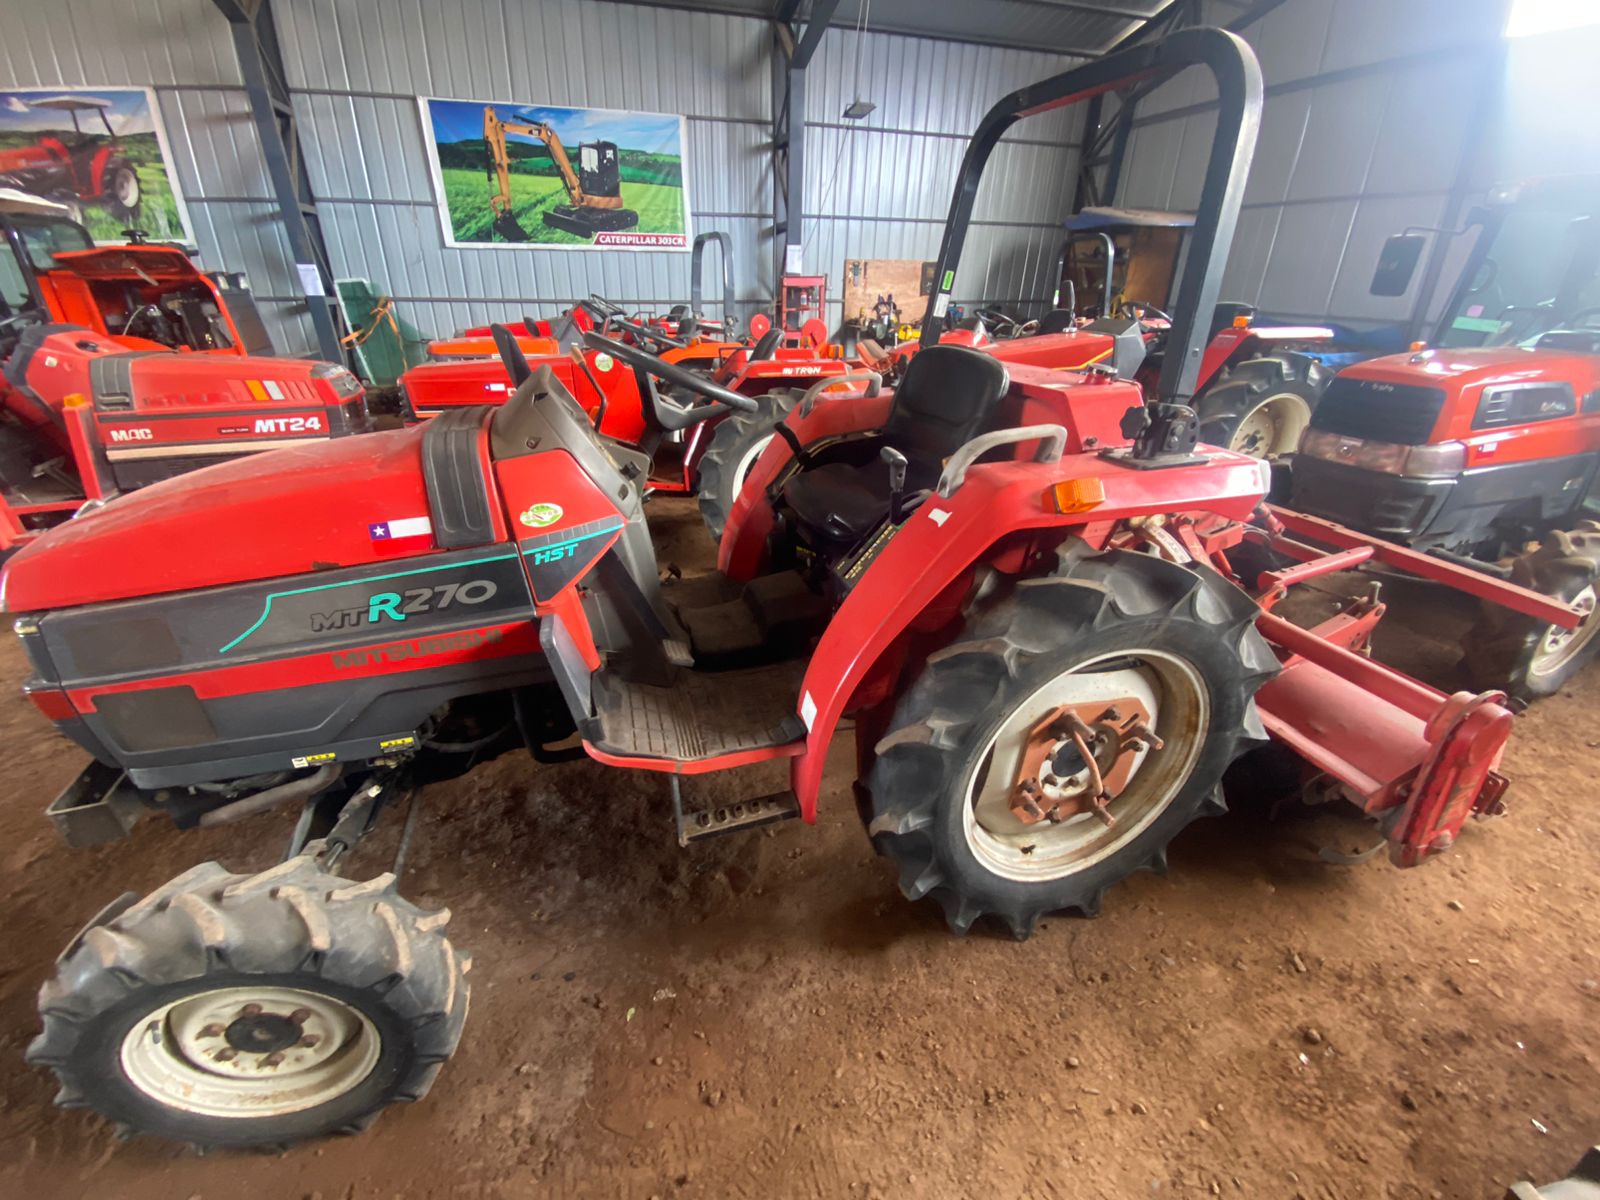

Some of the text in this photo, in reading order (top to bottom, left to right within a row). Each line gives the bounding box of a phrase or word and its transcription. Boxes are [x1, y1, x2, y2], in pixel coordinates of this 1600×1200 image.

[599, 235, 683, 246] CATERPILLAR 303CR
[254, 416, 321, 433] MT24
[534, 543, 578, 566] HST
[310, 579, 498, 632] MTR270
[331, 628, 502, 670] MITSUBISHI
